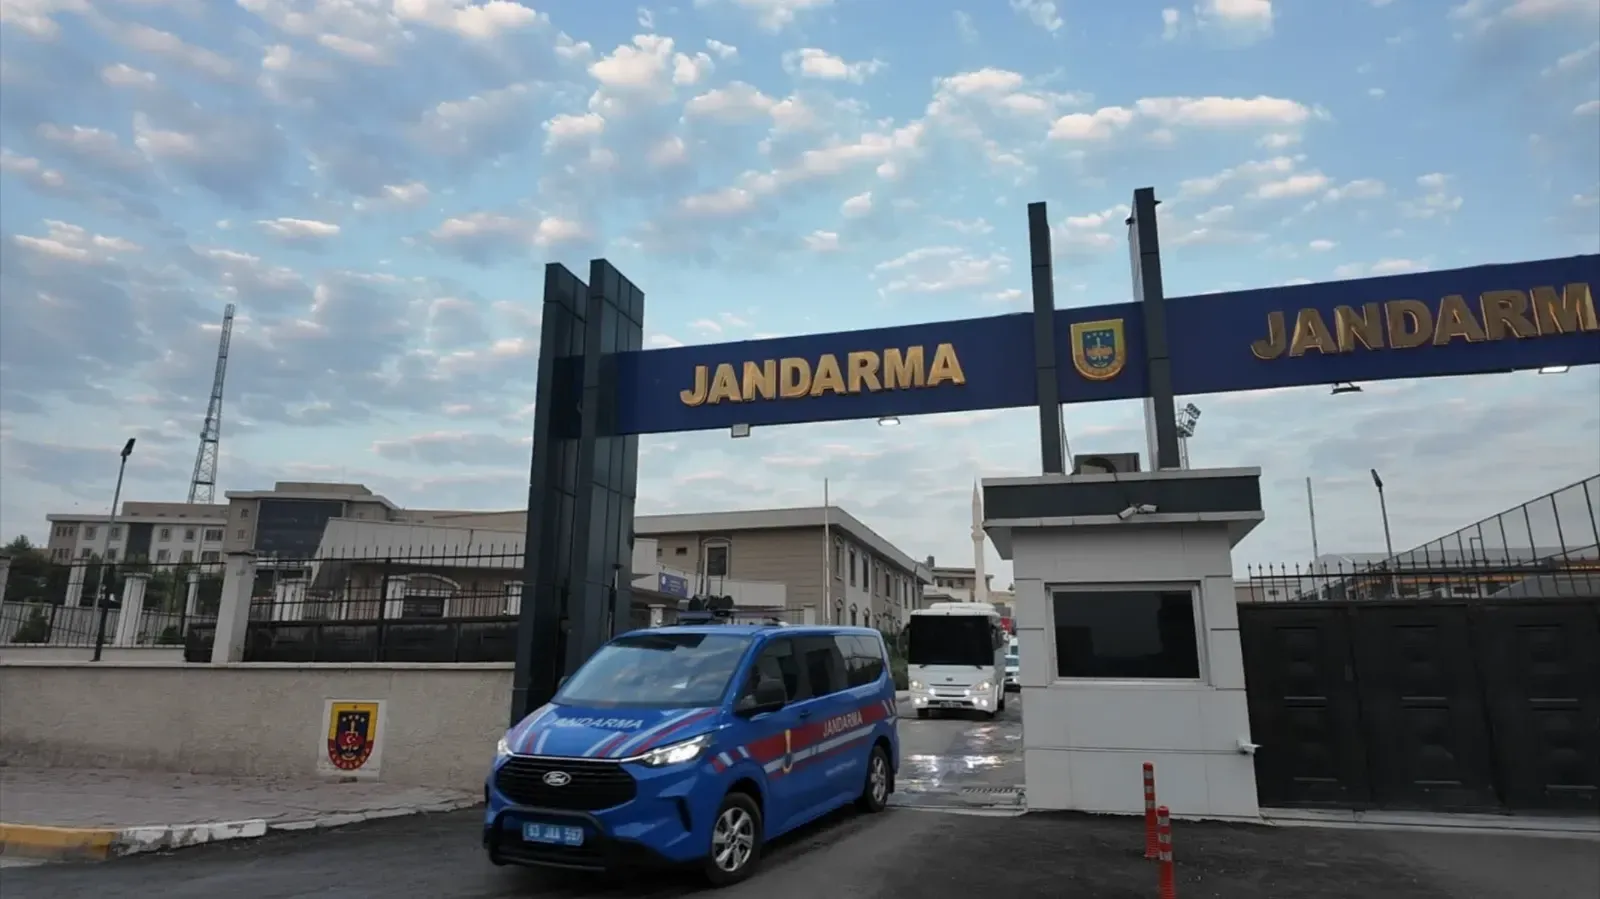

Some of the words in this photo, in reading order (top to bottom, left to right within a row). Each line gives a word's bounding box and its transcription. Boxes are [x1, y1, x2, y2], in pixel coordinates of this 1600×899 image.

[1251, 282, 1600, 360] JANDARM
[680, 343, 966, 407] JANDARMA
[823, 709, 863, 738] JANDARMA
